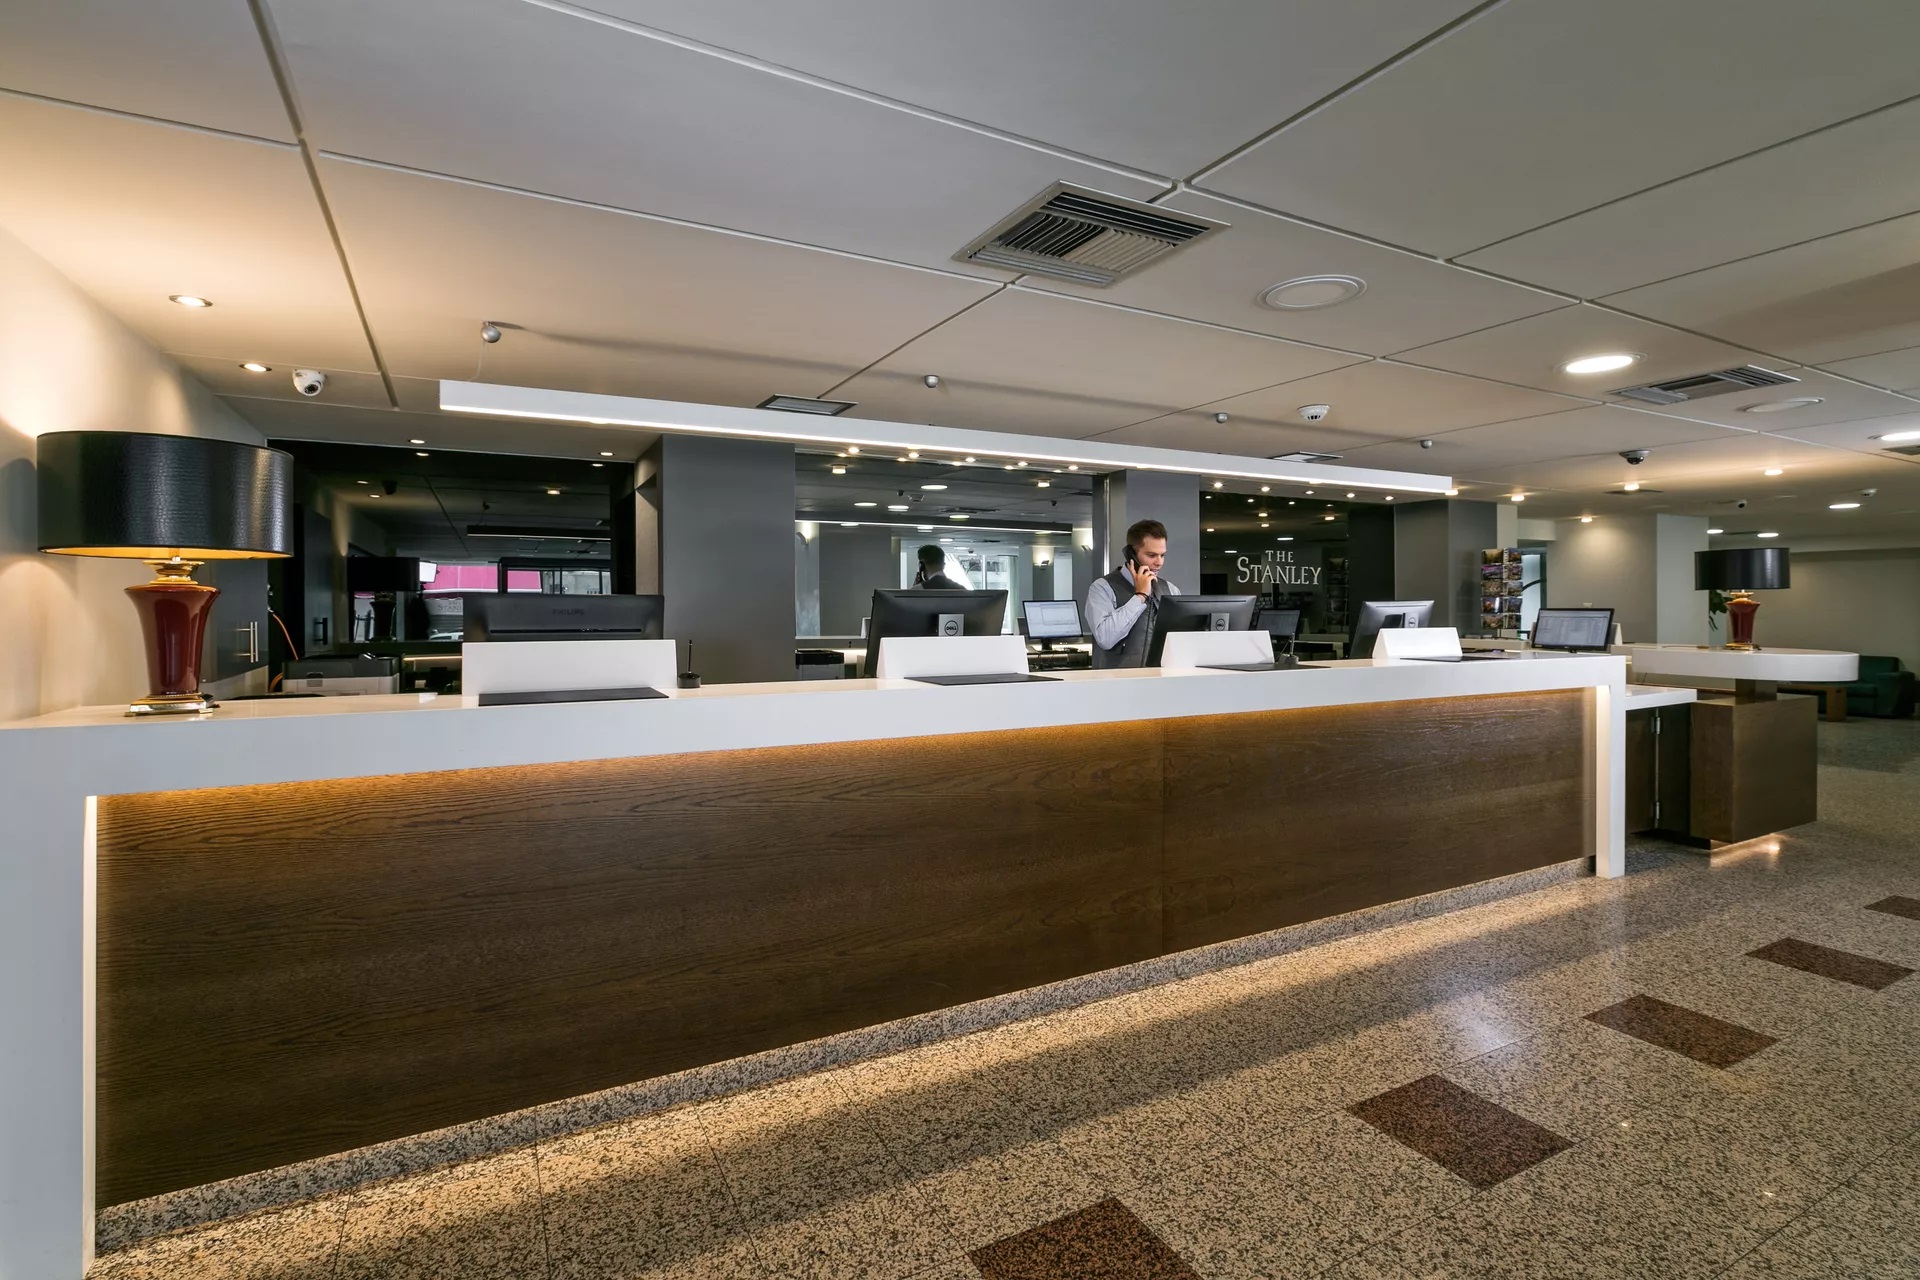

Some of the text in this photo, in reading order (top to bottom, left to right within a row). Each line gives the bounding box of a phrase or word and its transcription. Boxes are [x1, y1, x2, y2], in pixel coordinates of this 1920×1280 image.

[1265, 550, 1294, 563] THE
[1237, 556, 1322, 585] STANLEY
[552, 608, 585, 616] PHILIPS
